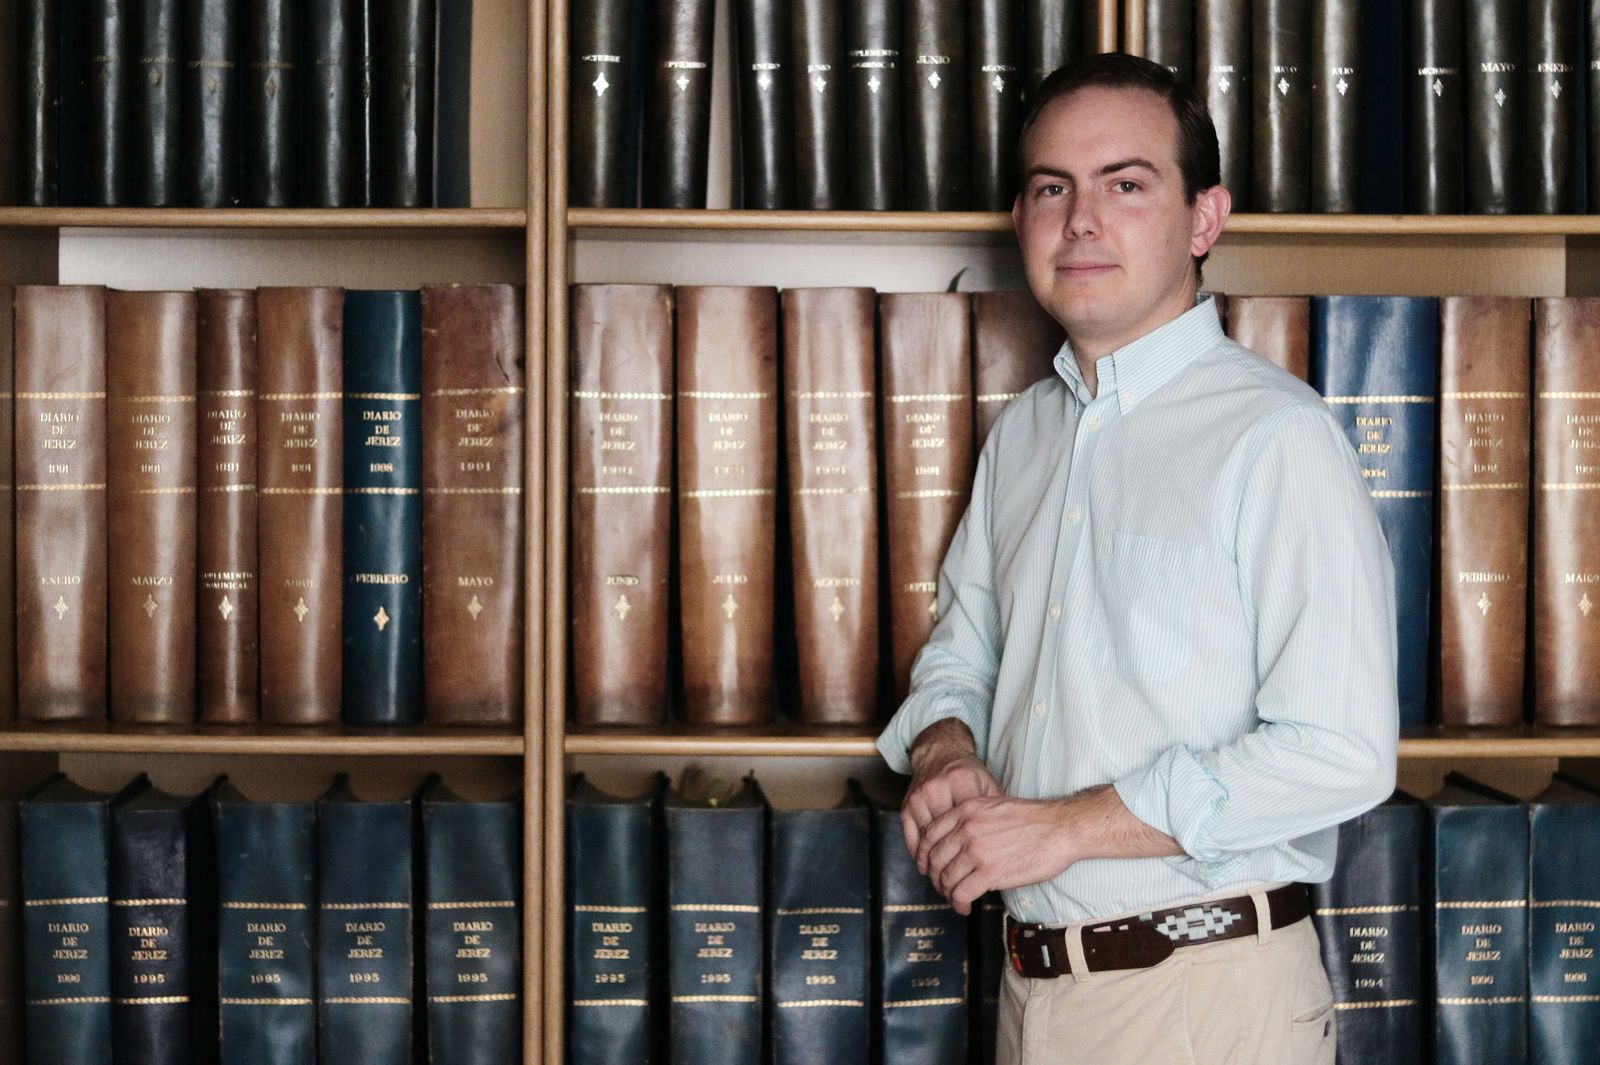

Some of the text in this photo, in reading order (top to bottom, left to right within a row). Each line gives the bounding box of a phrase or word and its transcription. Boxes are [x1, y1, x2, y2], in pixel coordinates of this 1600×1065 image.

[916, 55, 951, 64] JUNIO
[1481, 63, 1515, 72] MAYO
[40, 413, 79, 423] DIARIO
[208, 410, 246, 419] DIARIO
[281, 413, 320, 422] DIARIO
[363, 411, 402, 420] DIARIO
[456, 409, 494, 418] DIARIO
[600, 413, 638, 422] DIARIO
[709, 413, 748, 422] DIARIO
[810, 413, 848, 422] DIARIO
[906, 413, 946, 423] DIARIO
[1465, 413, 1505, 423] DIARIO
[132, 415, 170, 424] DIARIO
[1356, 417, 1392, 426] DIARIO
[51, 426, 67, 434] DE
[220, 421, 235, 431] DE
[375, 426, 389, 434] DE
[467, 424, 482, 432] DE
[143, 427, 158, 436] DE
[1367, 431, 1380, 440] DE
[213, 434, 246, 444] JEREZ
[284, 438, 318, 448] JEREZ
[365, 436, 400, 446] JEREZ
[458, 437, 493, 446] JEREZ
[911, 438, 945, 448] JEREZ
[42, 440, 76, 449] JEREZ
[133, 440, 168, 449] JEREZ
[813, 441, 847, 450] JEREZ
[1358, 444, 1391, 453] JEREZ
[1469, 439, 1503, 449] JEREZ
[41, 576, 80, 585] ENERO
[132, 576, 172, 585] MARZO
[356, 574, 409, 584] FEBRERO
[458, 577, 493, 586] MAYO
[605, 576, 639, 586] JUNIO
[48, 923, 89, 932] DIARIO
[247, 923, 286, 932] DIARIO
[345, 922, 385, 932] DIARIO
[453, 922, 493, 931] DIARIO
[592, 923, 633, 932] DIARIO
[695, 923, 736, 932] DIARIO
[799, 925, 841, 934] DIARIO
[1462, 925, 1502, 935] DIARIO
[1555, 923, 1595, 933] DIARIO
[129, 927, 168, 937] DIARIO
[905, 927, 944, 937] DIARIO
[1349, 927, 1388, 937] DIARIO
[63, 937, 78, 946] DE
[141, 939, 156, 948] DE
[258, 936, 274, 945] DE
[357, 936, 373, 945] DE
[464, 935, 480, 944] DE
[603, 936, 619, 946] DE
[708, 935, 723, 945] DE
[812, 937, 829, 947] DE
[1475, 938, 1491, 948] DE
[1568, 936, 1584, 946] DE
[917, 940, 934, 949] DE
[1360, 941, 1375, 950] DE
[53, 950, 88, 959] JEREZ
[132, 950, 167, 960] JEREZ
[249, 950, 284, 959] JEREZ
[347, 949, 383, 958] JEREZ
[455, 948, 491, 958] JEREZ
[593, 949, 630, 959] JEREZ
[697, 948, 733, 957] JEREZ
[801, 950, 838, 959] JEREZ
[1465, 951, 1501, 961] JEREZ
[1559, 948, 1594, 959] JEREZ
[907, 953, 942, 962] JEREZ
[1350, 953, 1384, 963] JEREZ
[134, 974, 165, 983] 1995
[251, 974, 281, 983] 1995
[349, 973, 380, 983] 1995
[458, 973, 488, 982] 1995
[595, 974, 626, 983] 1995
[701, 974, 731, 983] 1995
[805, 975, 836, 985] 1995
[1355, 978, 1384, 988] 1994
